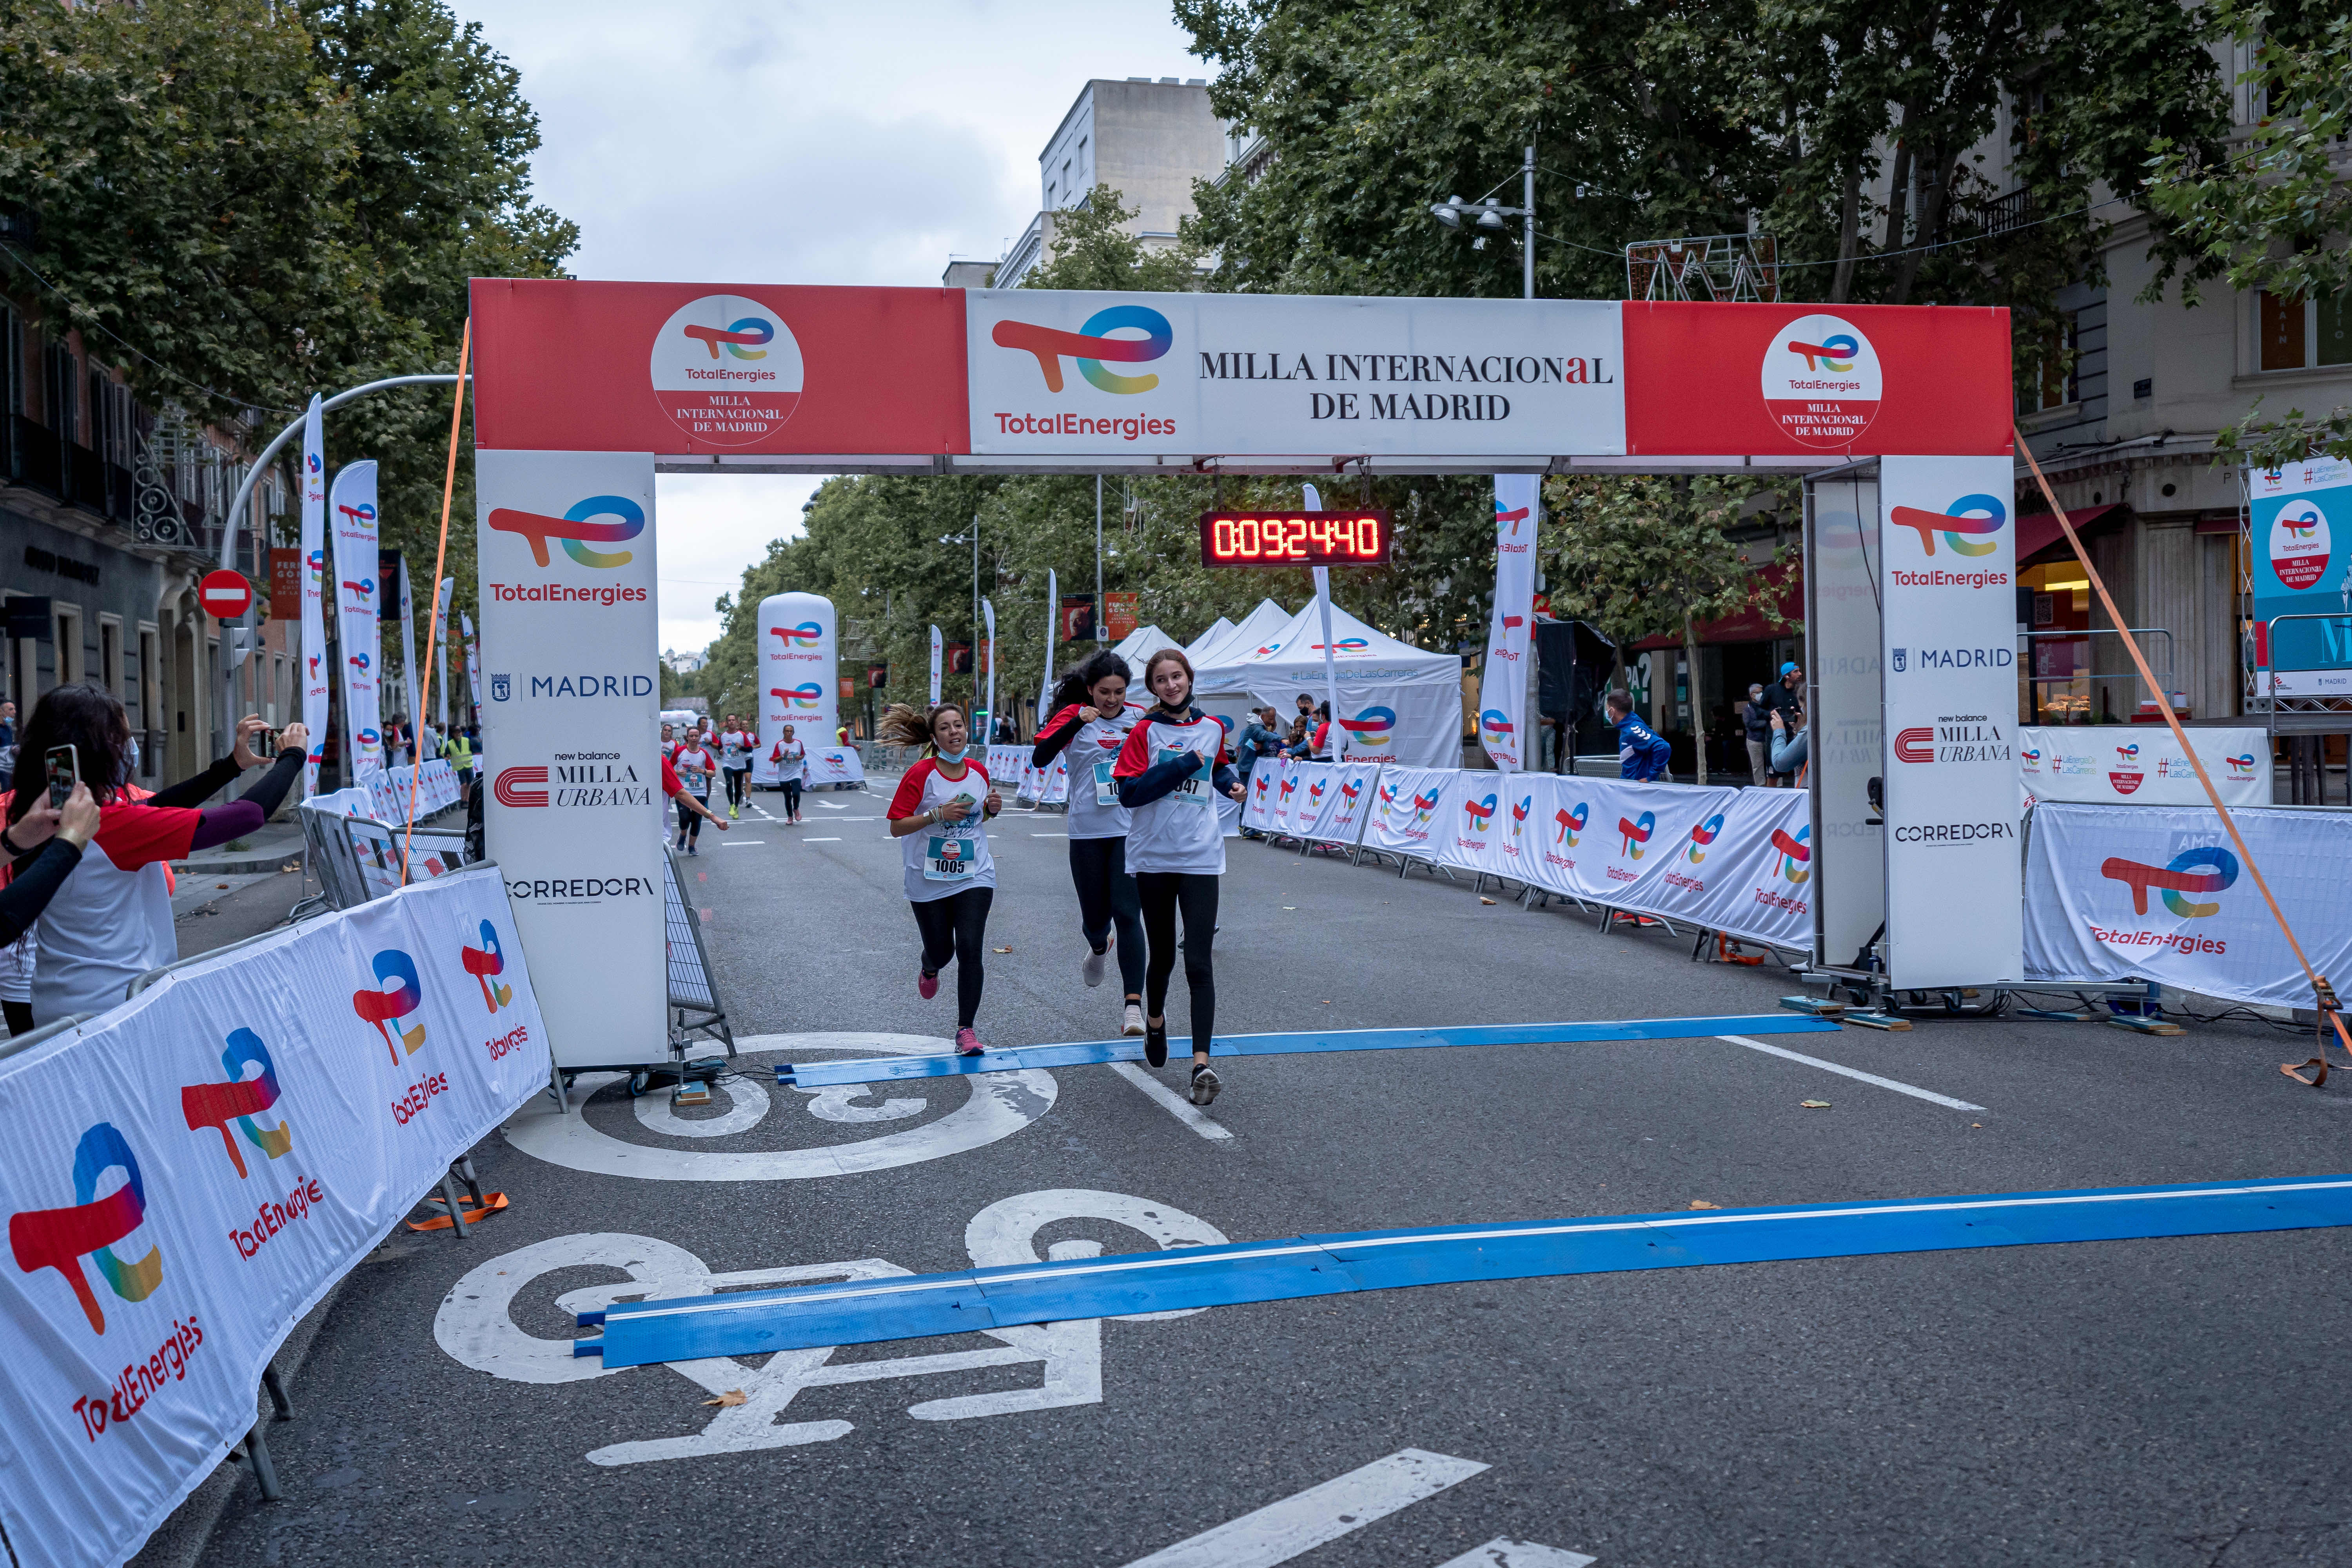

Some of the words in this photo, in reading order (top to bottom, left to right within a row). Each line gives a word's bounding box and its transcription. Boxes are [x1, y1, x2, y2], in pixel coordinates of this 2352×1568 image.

[1200, 351, 1318, 381] MILLA
[685, 369, 776, 383] TotalEnergies
[1789, 380, 1860, 392] TotalEnergies
[709, 396, 751, 406] MILLA
[1310, 393, 1360, 419] DE
[1370, 394, 1510, 421] MADRID
[1808, 404, 1841, 412] MILLA
[694, 422, 712, 432] DE
[715, 422, 768, 432] MADRID
[994, 412, 1176, 441] TotalEnergies
[1796, 427, 1810, 436] DE
[1813, 427, 1854, 436] MADRID
[340, 530, 377, 541] TotalEnergies
[2282, 543, 2319, 552] TotalEnergies
[1892, 570, 2007, 589] TotalEnergies
[489, 583, 646, 606] TotalEnergies
[770, 653, 822, 661] TotalEnergies
[1922, 648, 2012, 668] MADRID
[532, 675, 652, 697] MADRID
[771, 713, 822, 722] TotalEnergies
[1940, 726, 2002, 741] MILLA
[578, 751, 620, 760] balance
[1940, 745, 2012, 762] URBANA
[555, 764, 640, 784] MILLA
[557, 787, 652, 807] URBANA
[935, 859, 965, 873] 1005
